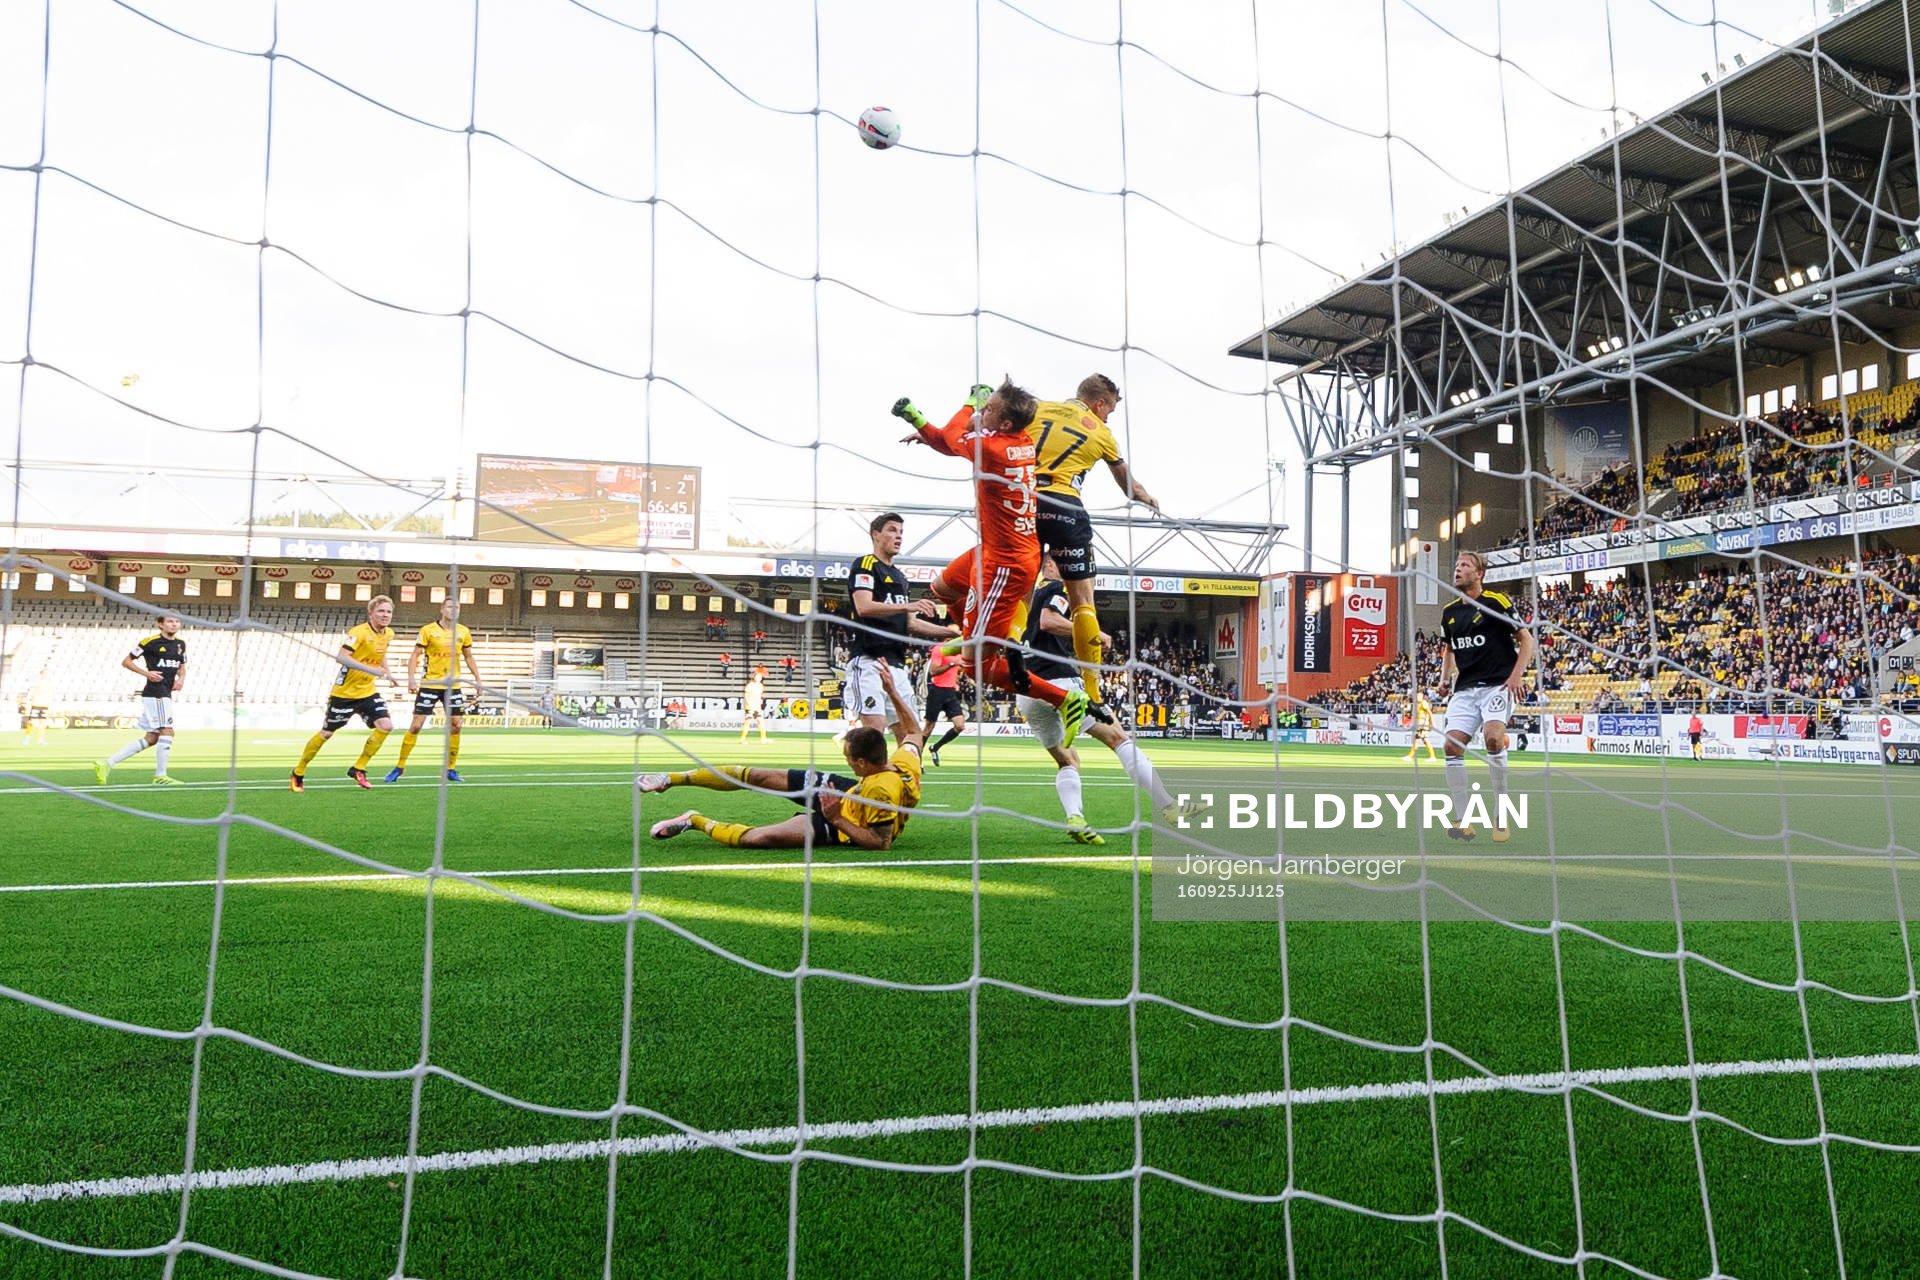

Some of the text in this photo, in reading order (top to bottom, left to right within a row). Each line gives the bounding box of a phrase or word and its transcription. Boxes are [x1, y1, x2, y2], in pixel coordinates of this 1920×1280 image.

[1036, 421, 1088, 470] 17
[650, 481, 657, 492] 1
[677, 481, 686, 494] 2
[648, 501, 688, 514] 66:45
[1891, 506, 1914, 519] UBAB
[1777, 520, 1837, 543] ellos ellos
[1716, 533, 1750, 551] SILVENT
[781, 560, 850, 578] ellos ello
[884, 592, 909, 604] ÅB
[1347, 594, 1382, 613] City
[1352, 634, 1378, 646] 7-23
[1136, 704, 1167, 727] 81
[1360, 732, 1390, 745] MECKA
[1588, 737, 1671, 755] Kimmos Måleri
[1704, 746, 1724, 755] BORS
[1793, 745, 1881, 763] ElkraftsByggarna
